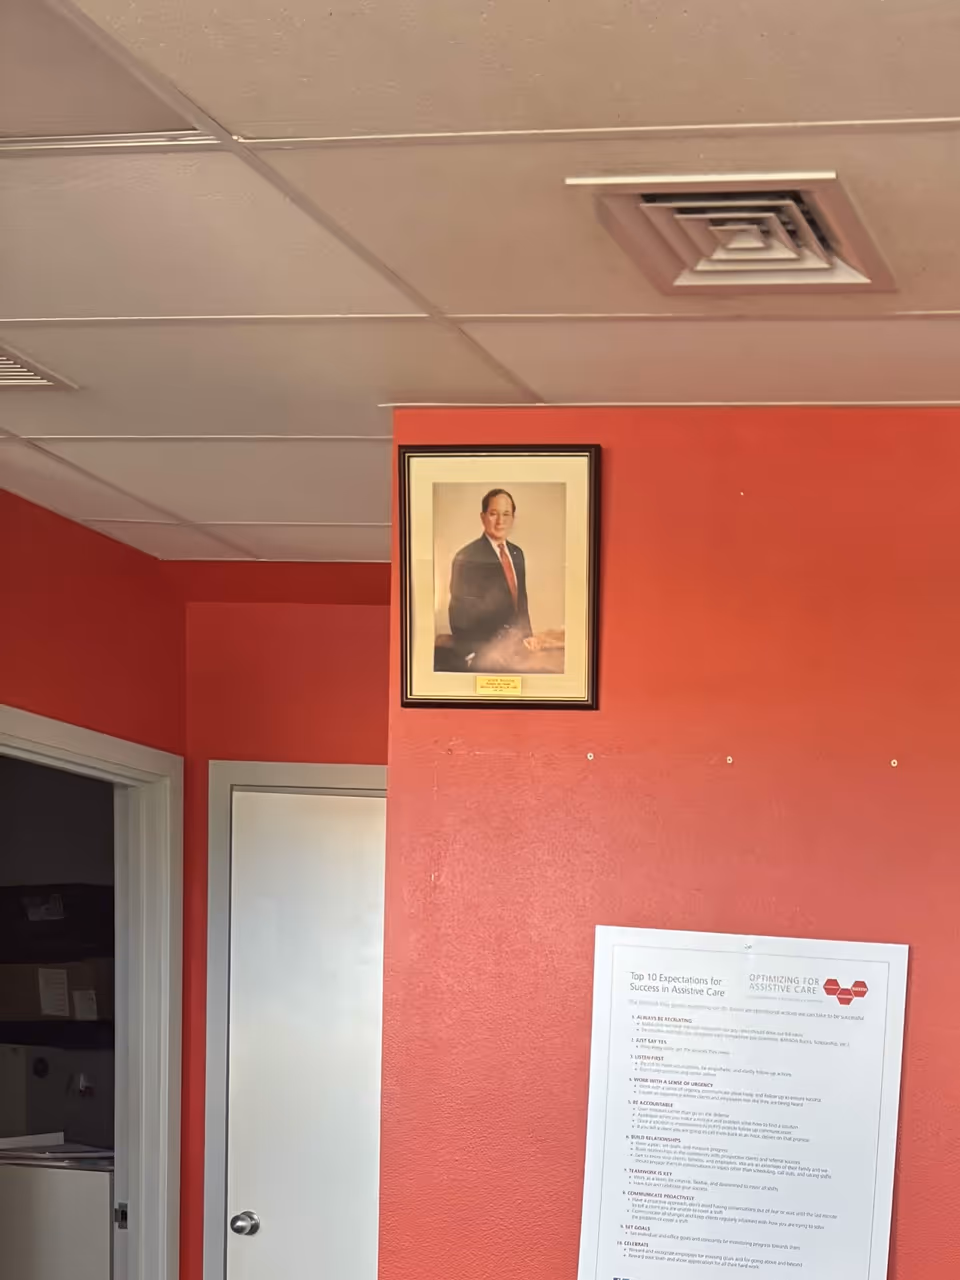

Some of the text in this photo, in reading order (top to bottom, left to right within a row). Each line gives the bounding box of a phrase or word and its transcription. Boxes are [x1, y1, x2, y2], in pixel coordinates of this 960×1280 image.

[629, 971, 721, 986] Top 10 Expectations for
[748, 973, 820, 986] OPTIMIZING FOR
[629, 982, 725, 997] Success in Assistive Care
[748, 982, 791, 992] ASSISTIVE
[793, 985, 817, 994] CARE
[645, 1135, 681, 1143] RELATIONSHIPS
[626, 1190, 662, 1198] COMMUNICATE
[663, 1193, 695, 1201] PROACTIVELY
